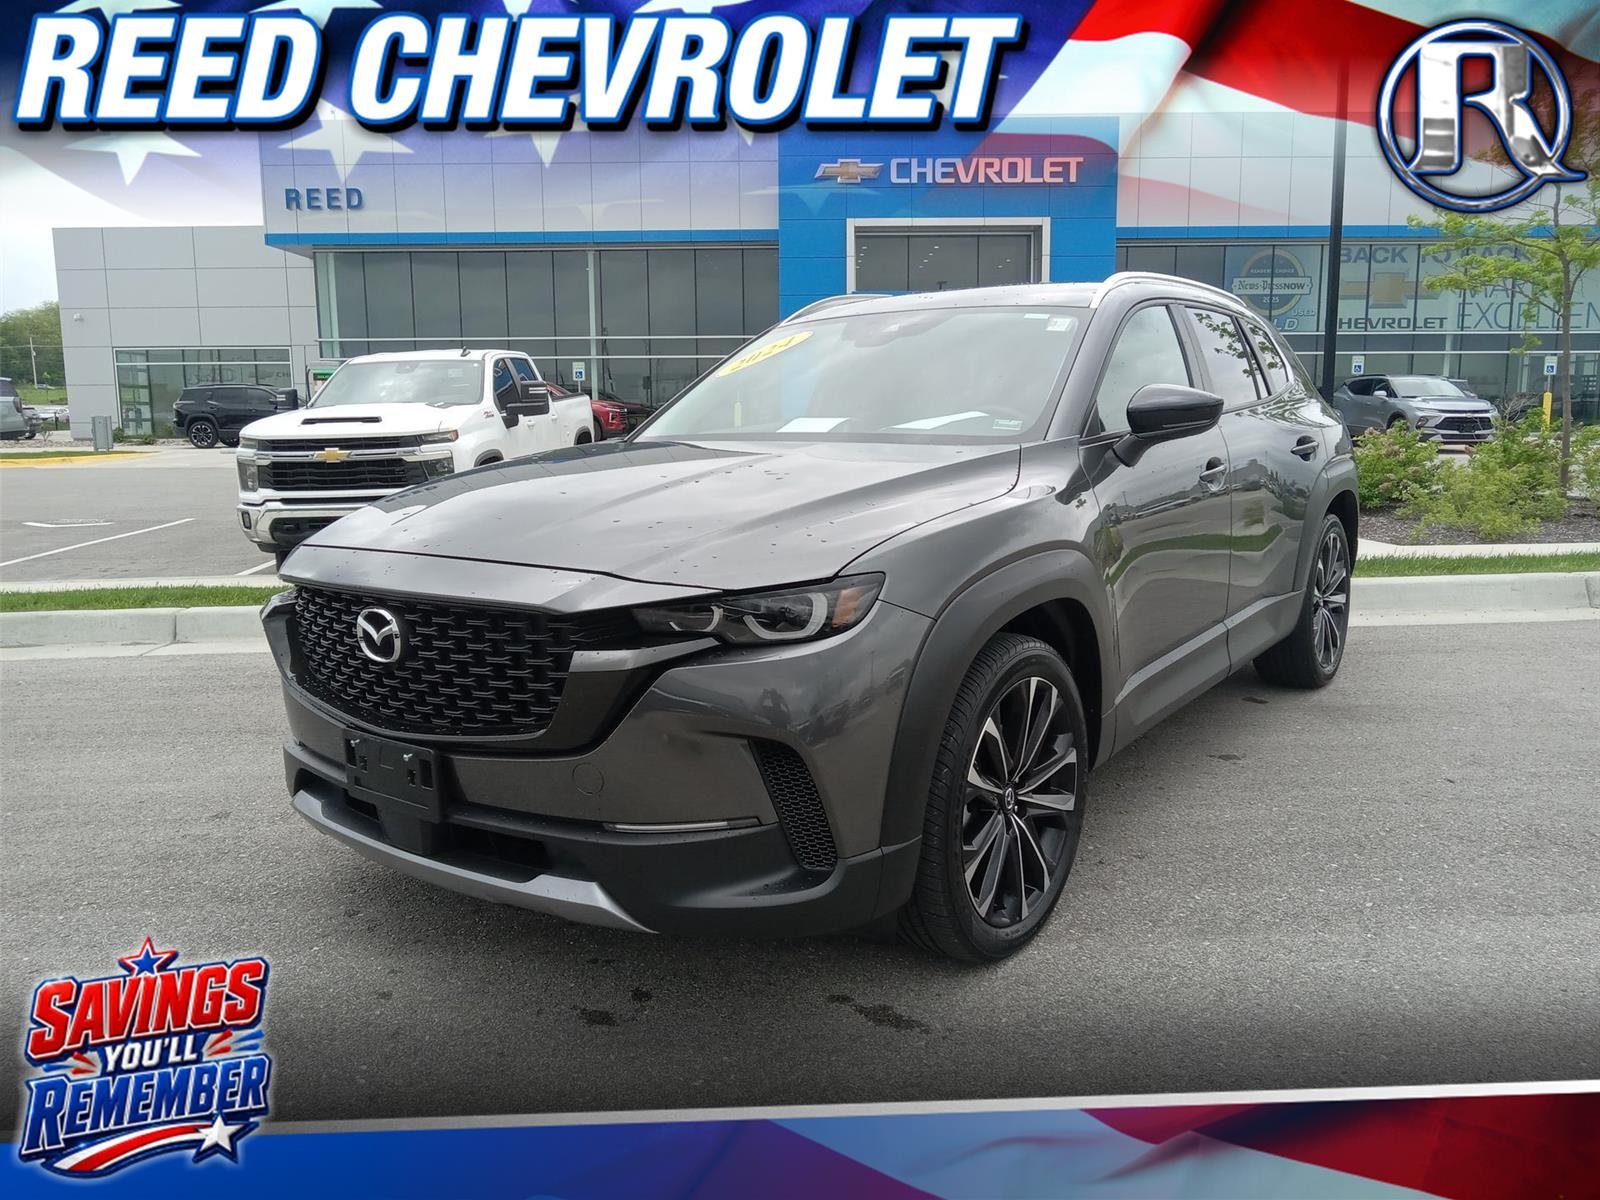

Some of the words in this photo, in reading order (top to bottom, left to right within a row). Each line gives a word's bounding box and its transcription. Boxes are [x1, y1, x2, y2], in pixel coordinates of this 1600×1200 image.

[889, 157, 1084, 184] CHEVROLET
[284, 187, 364, 211] REED
[1340, 246, 1408, 264] BACK
[1338, 316, 1448, 330] HEVROLET
